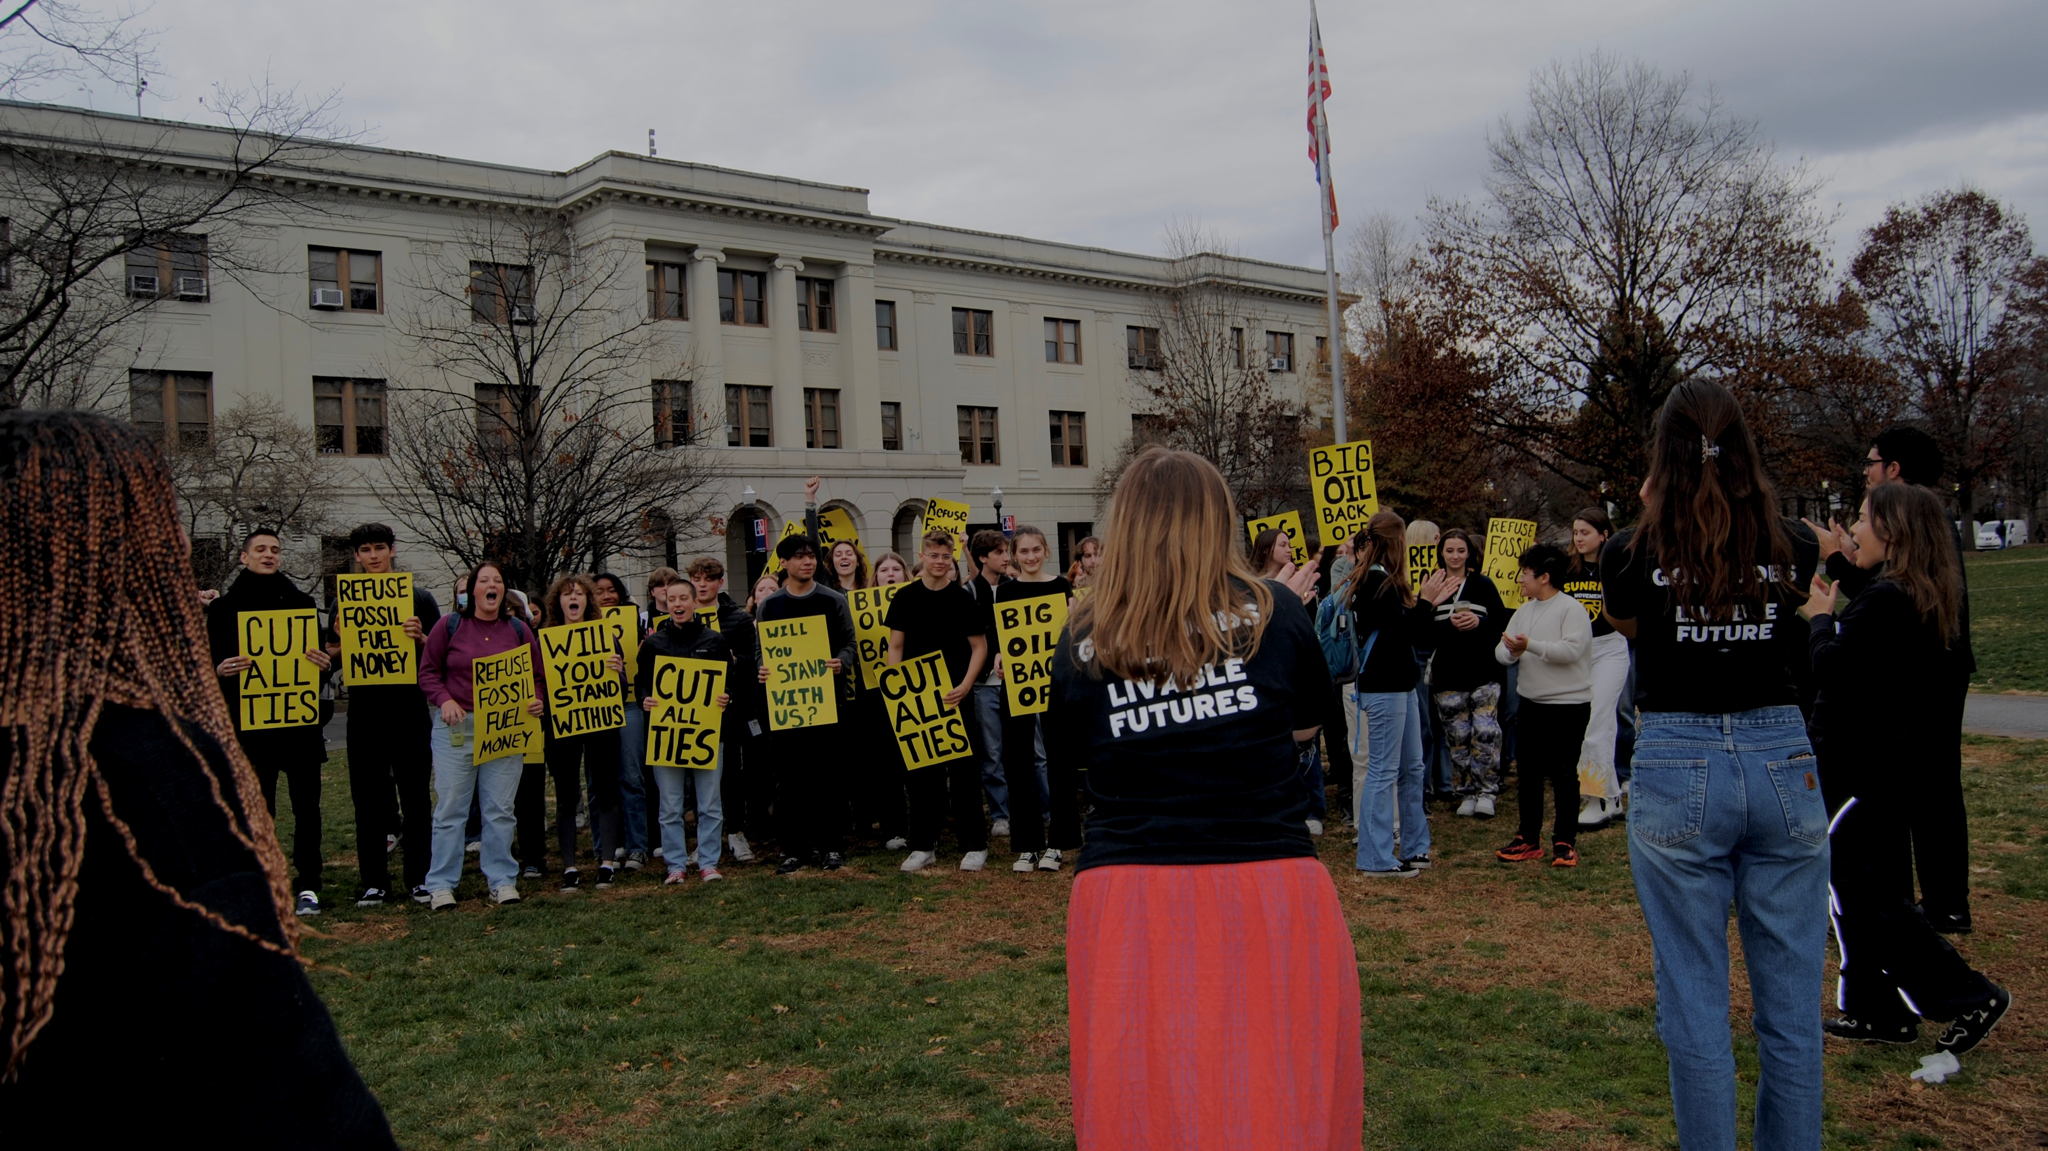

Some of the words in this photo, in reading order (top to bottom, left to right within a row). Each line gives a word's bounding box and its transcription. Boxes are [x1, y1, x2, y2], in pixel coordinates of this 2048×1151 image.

[1313, 444, 1370, 477] BIG
[1324, 475, 1372, 504] OIL
[1322, 504, 1369, 524] BACK
[1490, 520, 1536, 538] REFUSE
[1408, 545, 1435, 568] REF
[339, 576, 409, 602] REFUSE
[854, 587, 897, 611] BIG
[343, 606, 403, 628] FOSSIL
[859, 609, 884, 630] OI
[1001, 603, 1052, 630] BIG
[246, 615, 315, 656] CUT
[358, 629, 399, 650] FUEL
[543, 624, 611, 659] WILL
[766, 623, 808, 638] WILL
[1008, 631, 1057, 657] OIL
[1676, 623, 1773, 643] FUTURE
[765, 646, 792, 658] YOU
[860, 636, 889, 662] BA
[243, 659, 310, 689] ALL
[350, 651, 408, 679] MONEY
[475, 652, 530, 686] REFUSE
[554, 660, 605, 686] YOU
[777, 659, 827, 683] STAND
[879, 653, 943, 700] CUT
[1011, 656, 1053, 684] BAC
[479, 678, 534, 709] FOSSIL
[554, 680, 620, 708] STAND
[656, 663, 722, 706] CUT
[771, 686, 824, 706] WITH
[1018, 684, 1051, 707] OF
[242, 690, 318, 726] TIES
[486, 706, 524, 735] FUEL
[660, 706, 700, 725] ALL
[895, 689, 956, 732] ALL
[1109, 685, 1258, 738] FUTURES
[479, 730, 533, 759] MONEY
[652, 725, 716, 765] TIES
[899, 718, 969, 764] TIES
